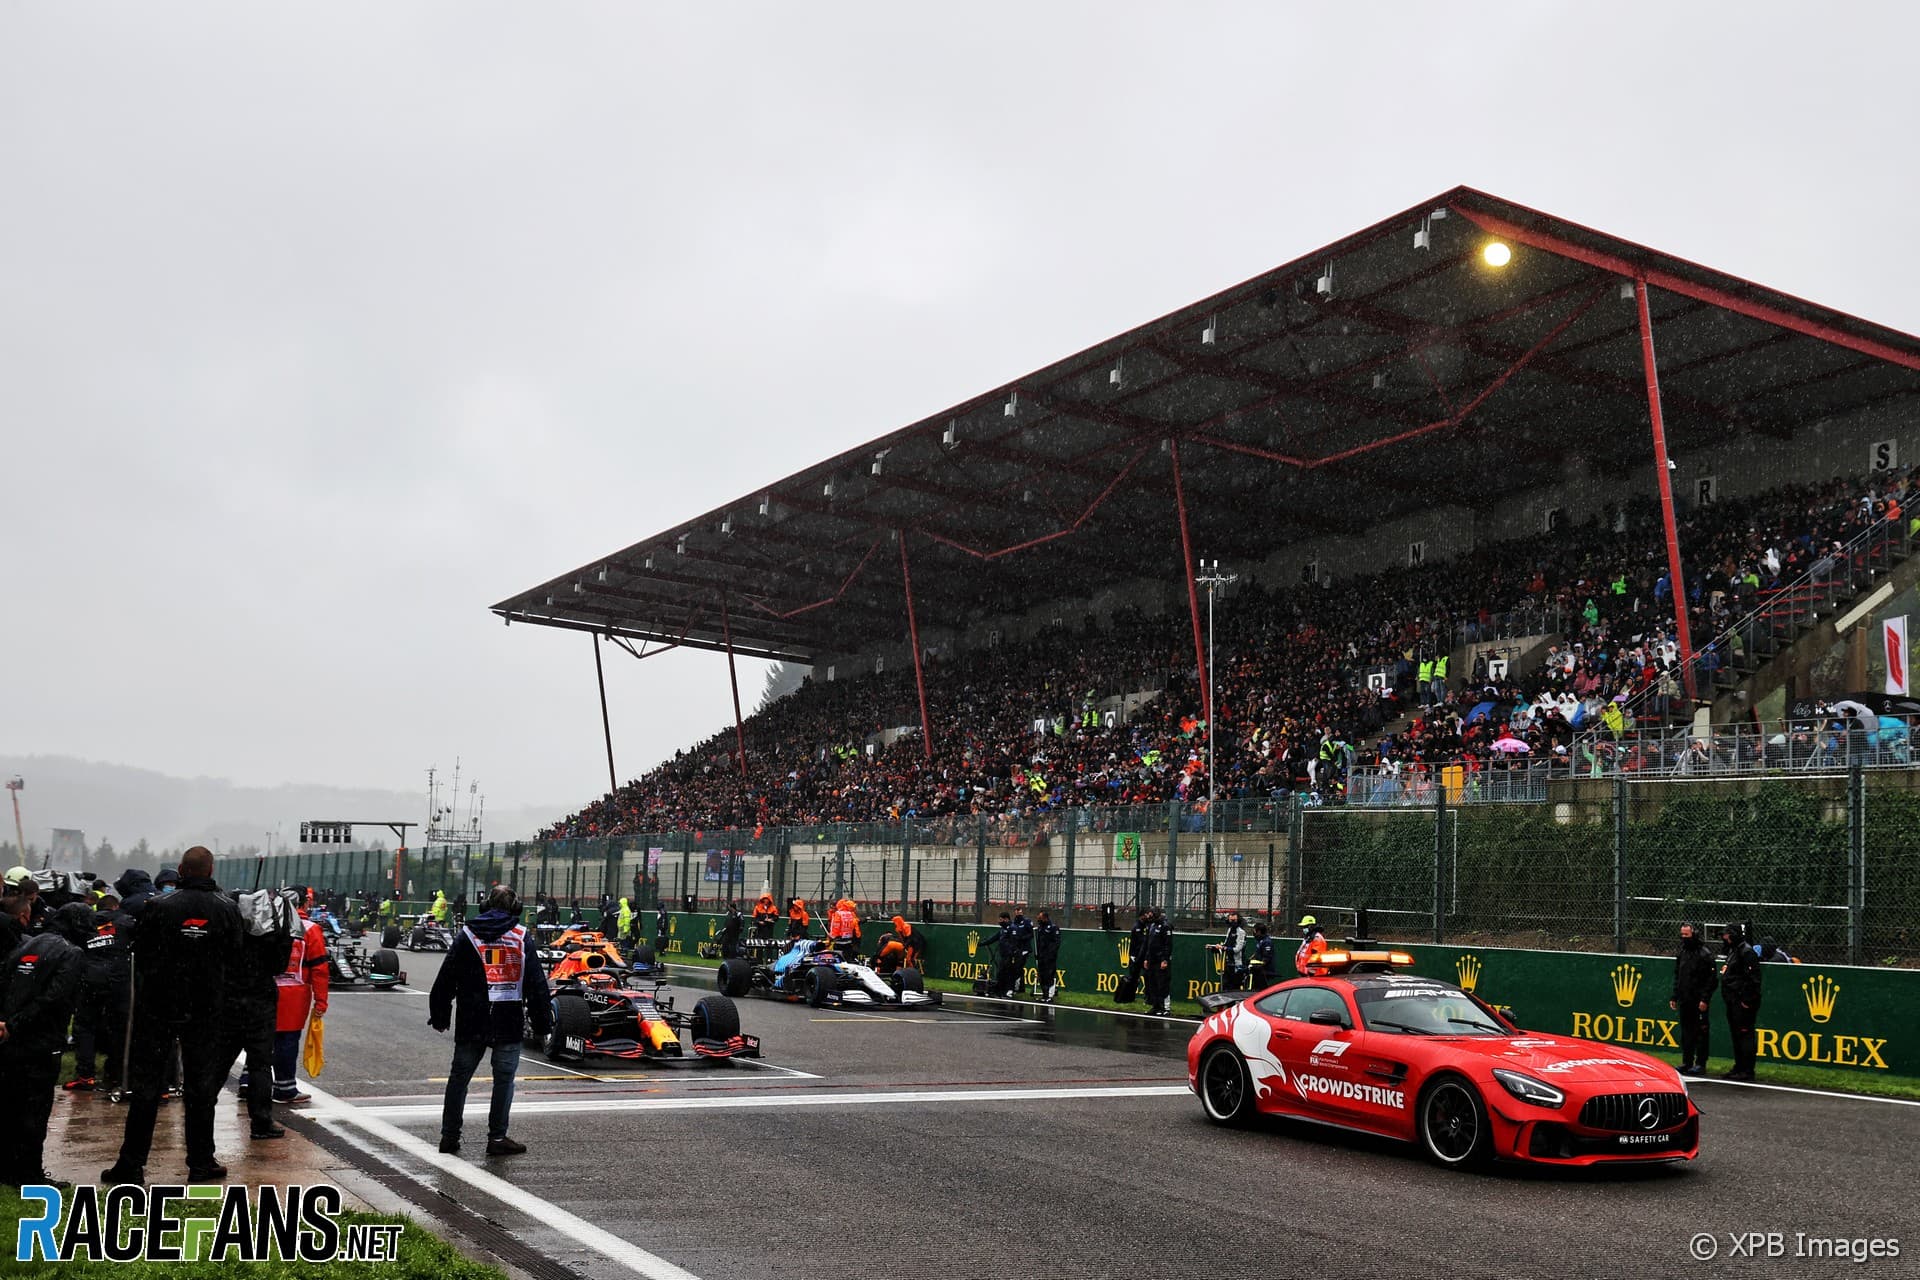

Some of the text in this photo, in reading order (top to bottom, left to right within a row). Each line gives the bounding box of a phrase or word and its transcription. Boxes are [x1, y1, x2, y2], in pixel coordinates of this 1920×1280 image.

[1876, 443, 1890, 470] S
[1699, 479, 1711, 504] R
[583, 992, 609, 1005] ORACLE
[1571, 1012, 1681, 1048] ROLEX
[565, 1036, 580, 1051] Mobil
[1756, 1028, 1889, 1069] ROLEX
[1299, 1073, 1405, 1109] CROWDSTRIKE
[1629, 1135, 1657, 1144] SAFETY
[1657, 1134, 1670, 1143] CAR
